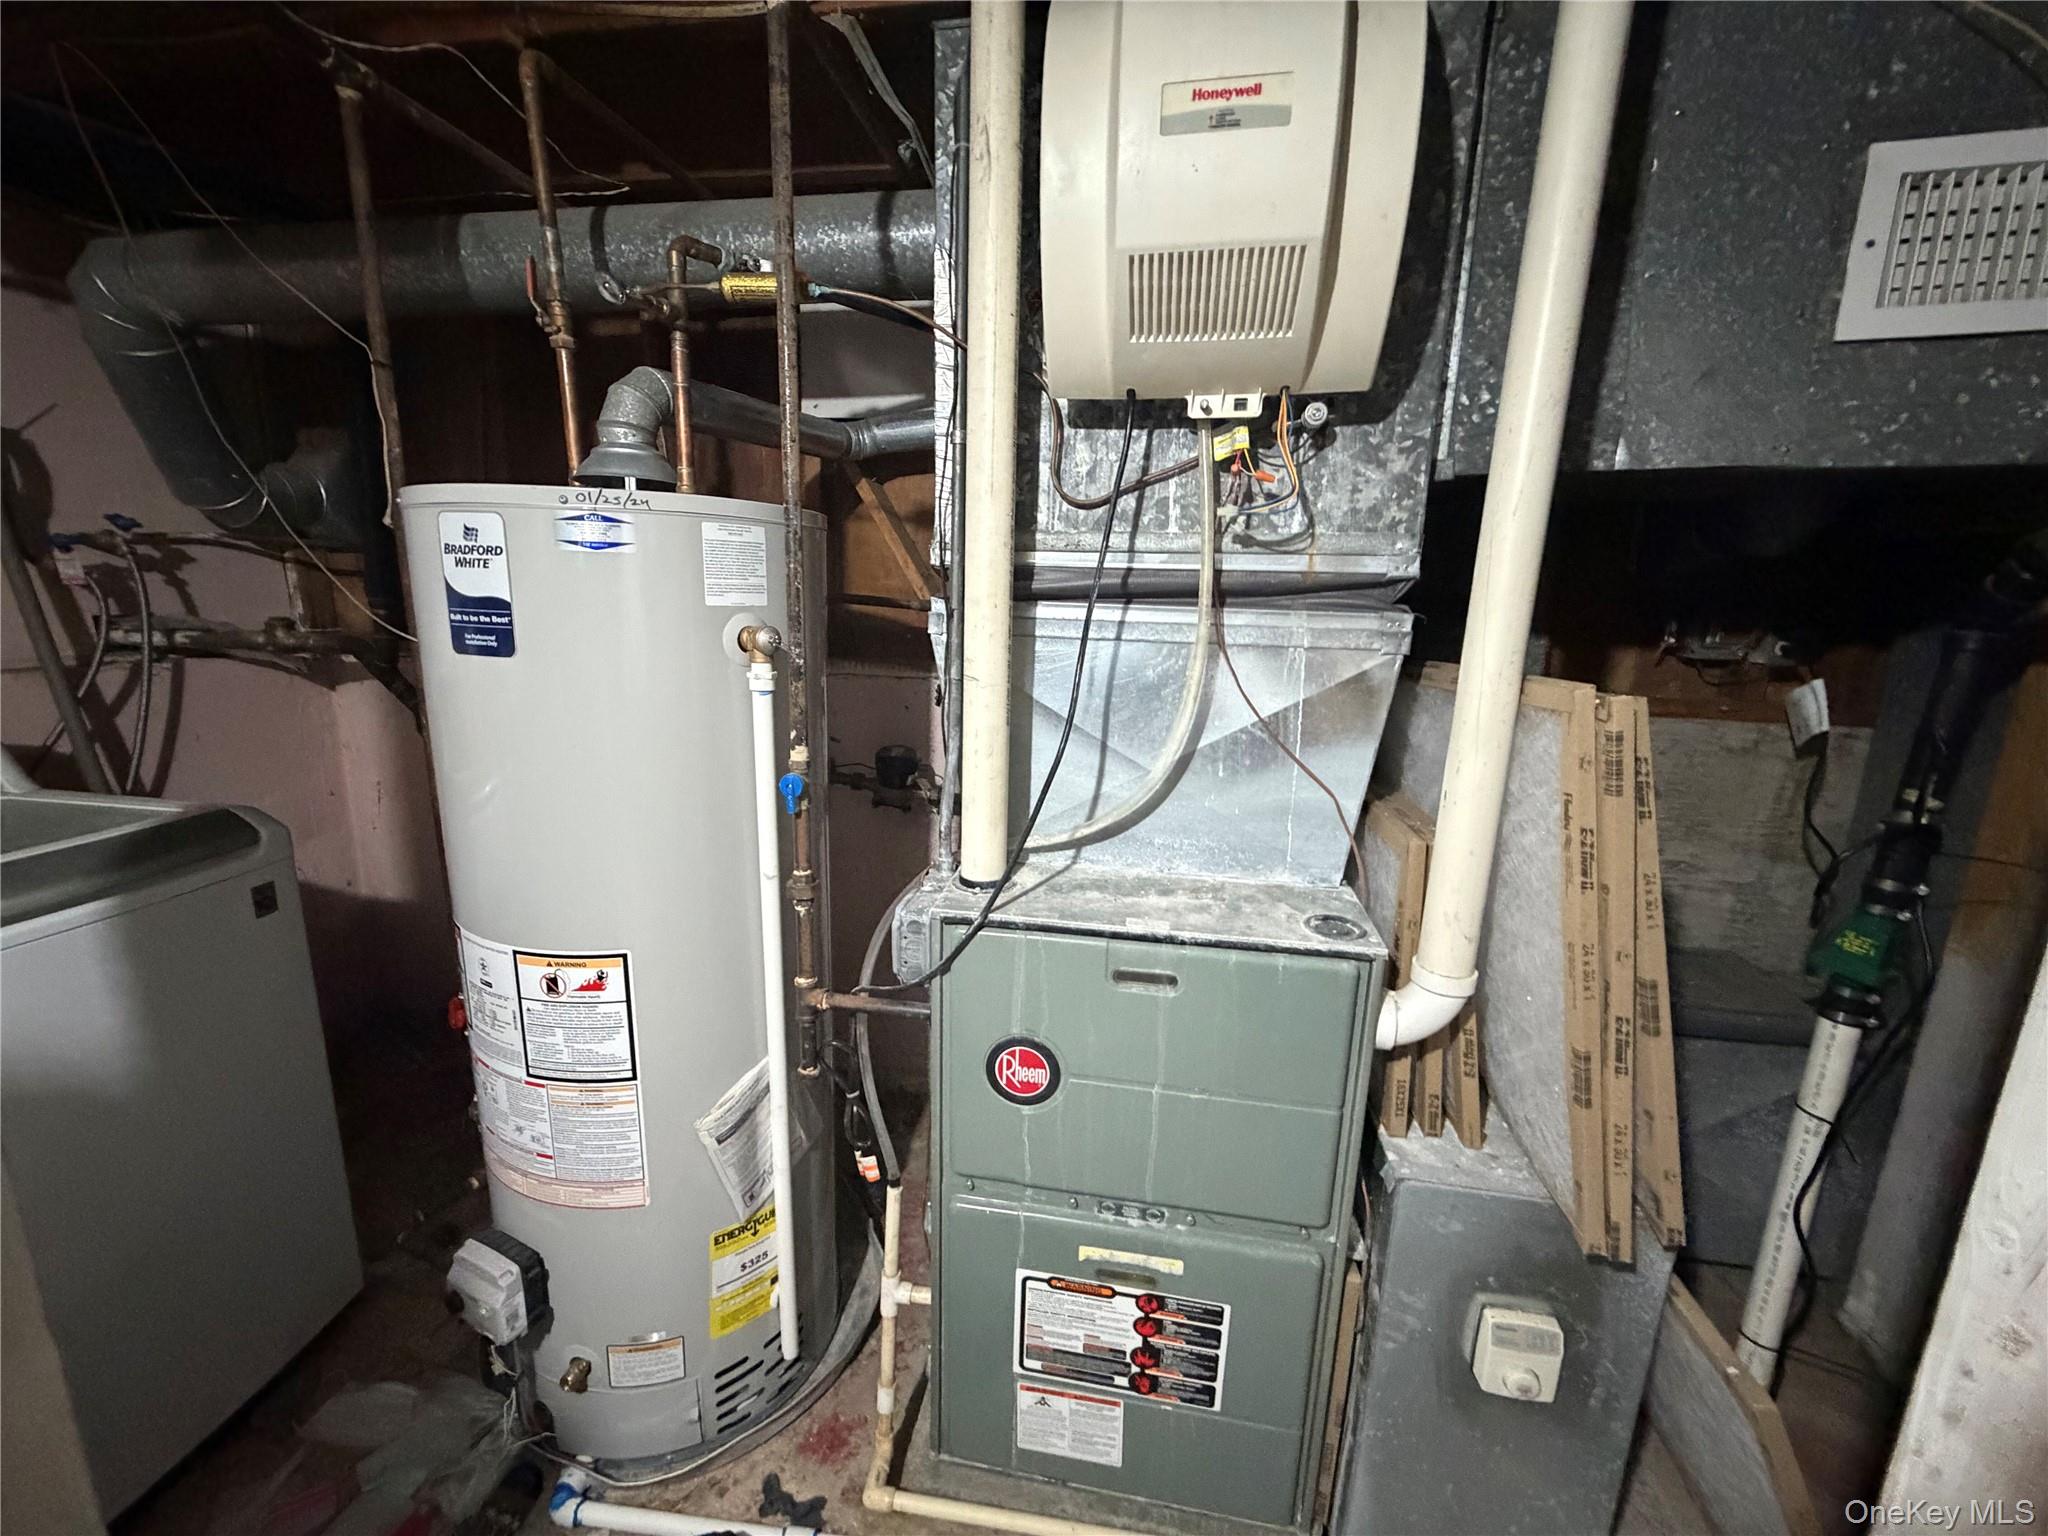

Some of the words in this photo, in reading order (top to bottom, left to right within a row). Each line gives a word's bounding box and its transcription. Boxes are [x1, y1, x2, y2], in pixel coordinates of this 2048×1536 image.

[1191, 83, 1263, 101] Honeywell
[575, 487, 653, 511] 01/25/24
[443, 542, 504, 556] BRADFORD
[454, 556, 490, 569] WHITE
[1002, 1048, 1046, 1088] Rheem
[740, 1250, 769, 1272] $325
